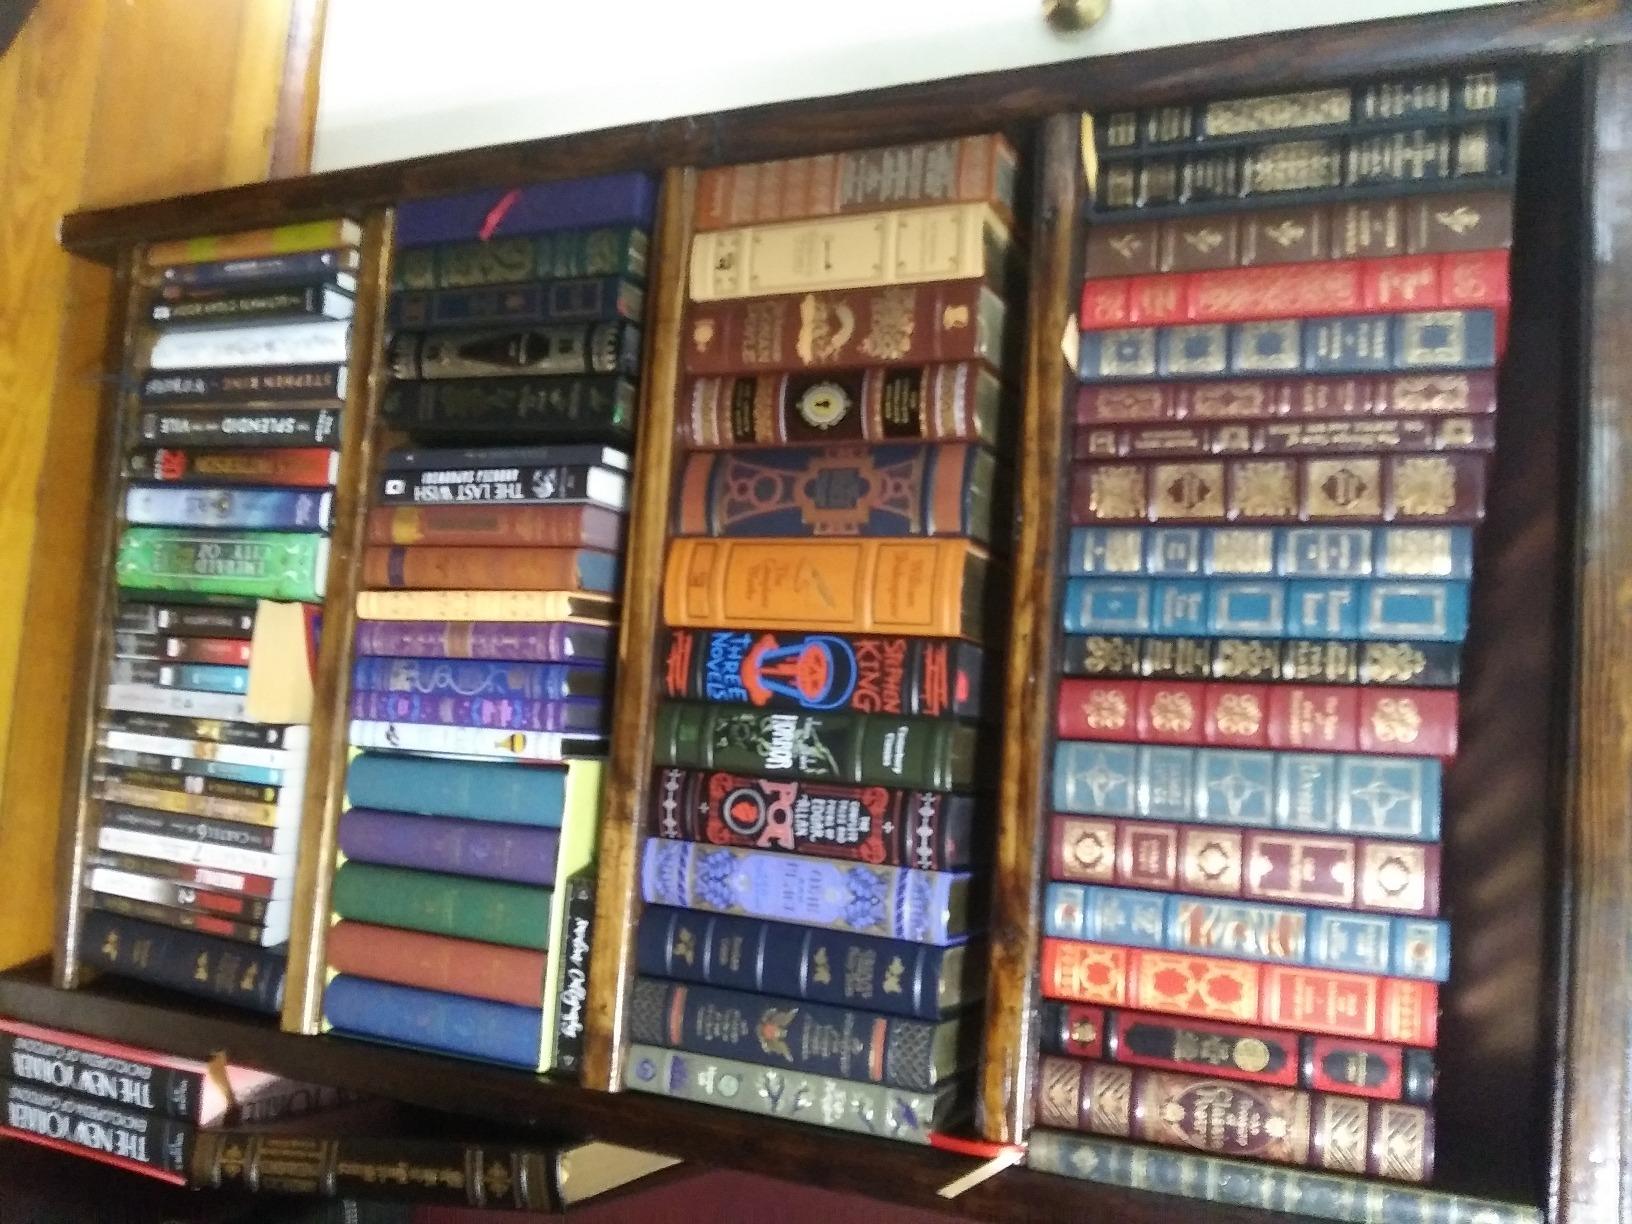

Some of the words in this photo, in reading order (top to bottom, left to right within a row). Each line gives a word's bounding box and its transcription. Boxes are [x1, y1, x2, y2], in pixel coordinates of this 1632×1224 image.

[413, 484, 453, 502] WISH
[455, 483, 491, 501] LAST
[493, 483, 525, 500] THE
[706, 632, 734, 700] NOVELS
[727, 634, 753, 702] THREE
[848, 640, 884, 713] KING
[882, 639, 906, 713] STEPHEN
[764, 714, 799, 770] HORROR
[757, 780, 798, 850] POE
[77, 1070, 117, 1100] NEW
[116, 1081, 155, 1109] THE
[74, 1121, 114, 1153] NEW
[113, 1130, 150, 1162] THE
